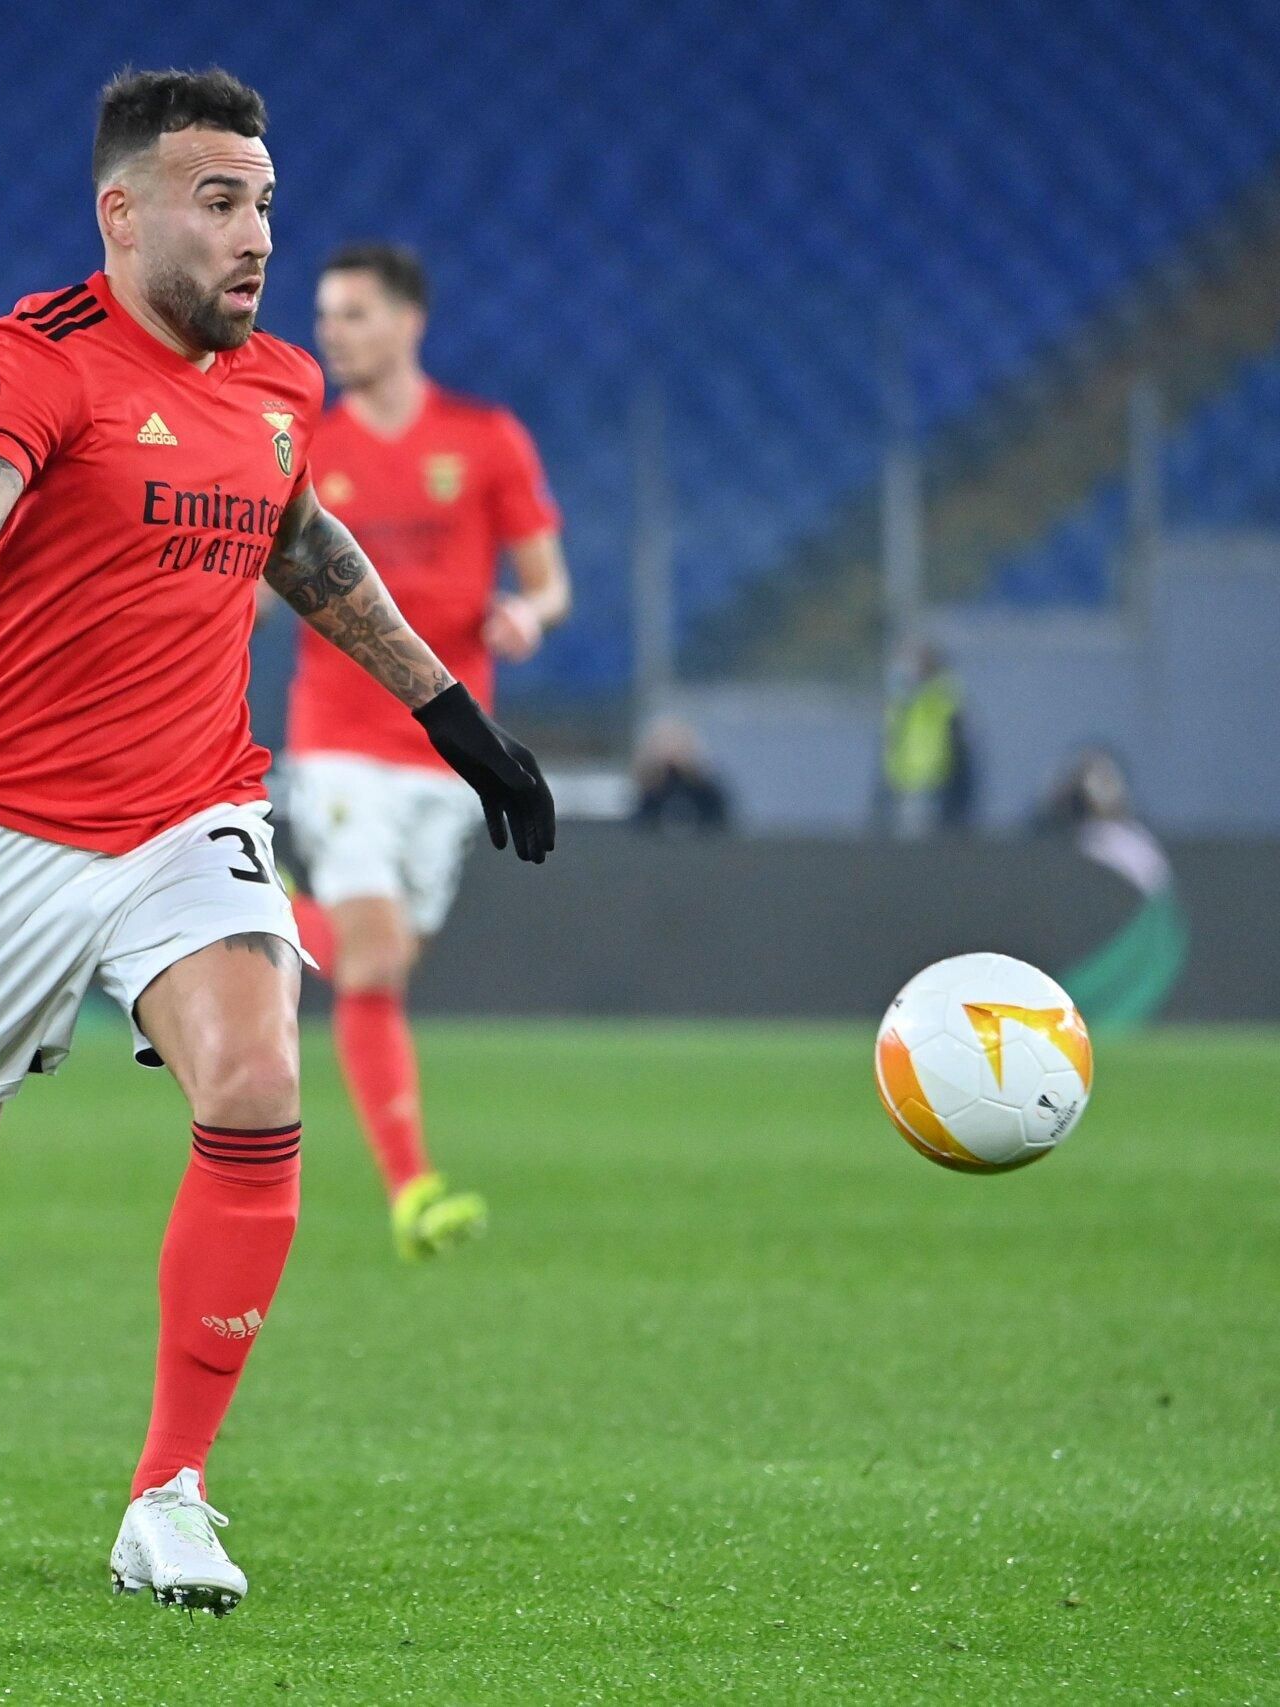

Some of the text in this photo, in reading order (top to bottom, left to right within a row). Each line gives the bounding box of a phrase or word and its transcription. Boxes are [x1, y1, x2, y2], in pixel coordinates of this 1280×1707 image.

[137, 431, 178, 446] adidas
[143, 480, 283, 538] Emirate
[158, 536, 202, 570] FLY
[201, 1316, 263, 1340] adida
